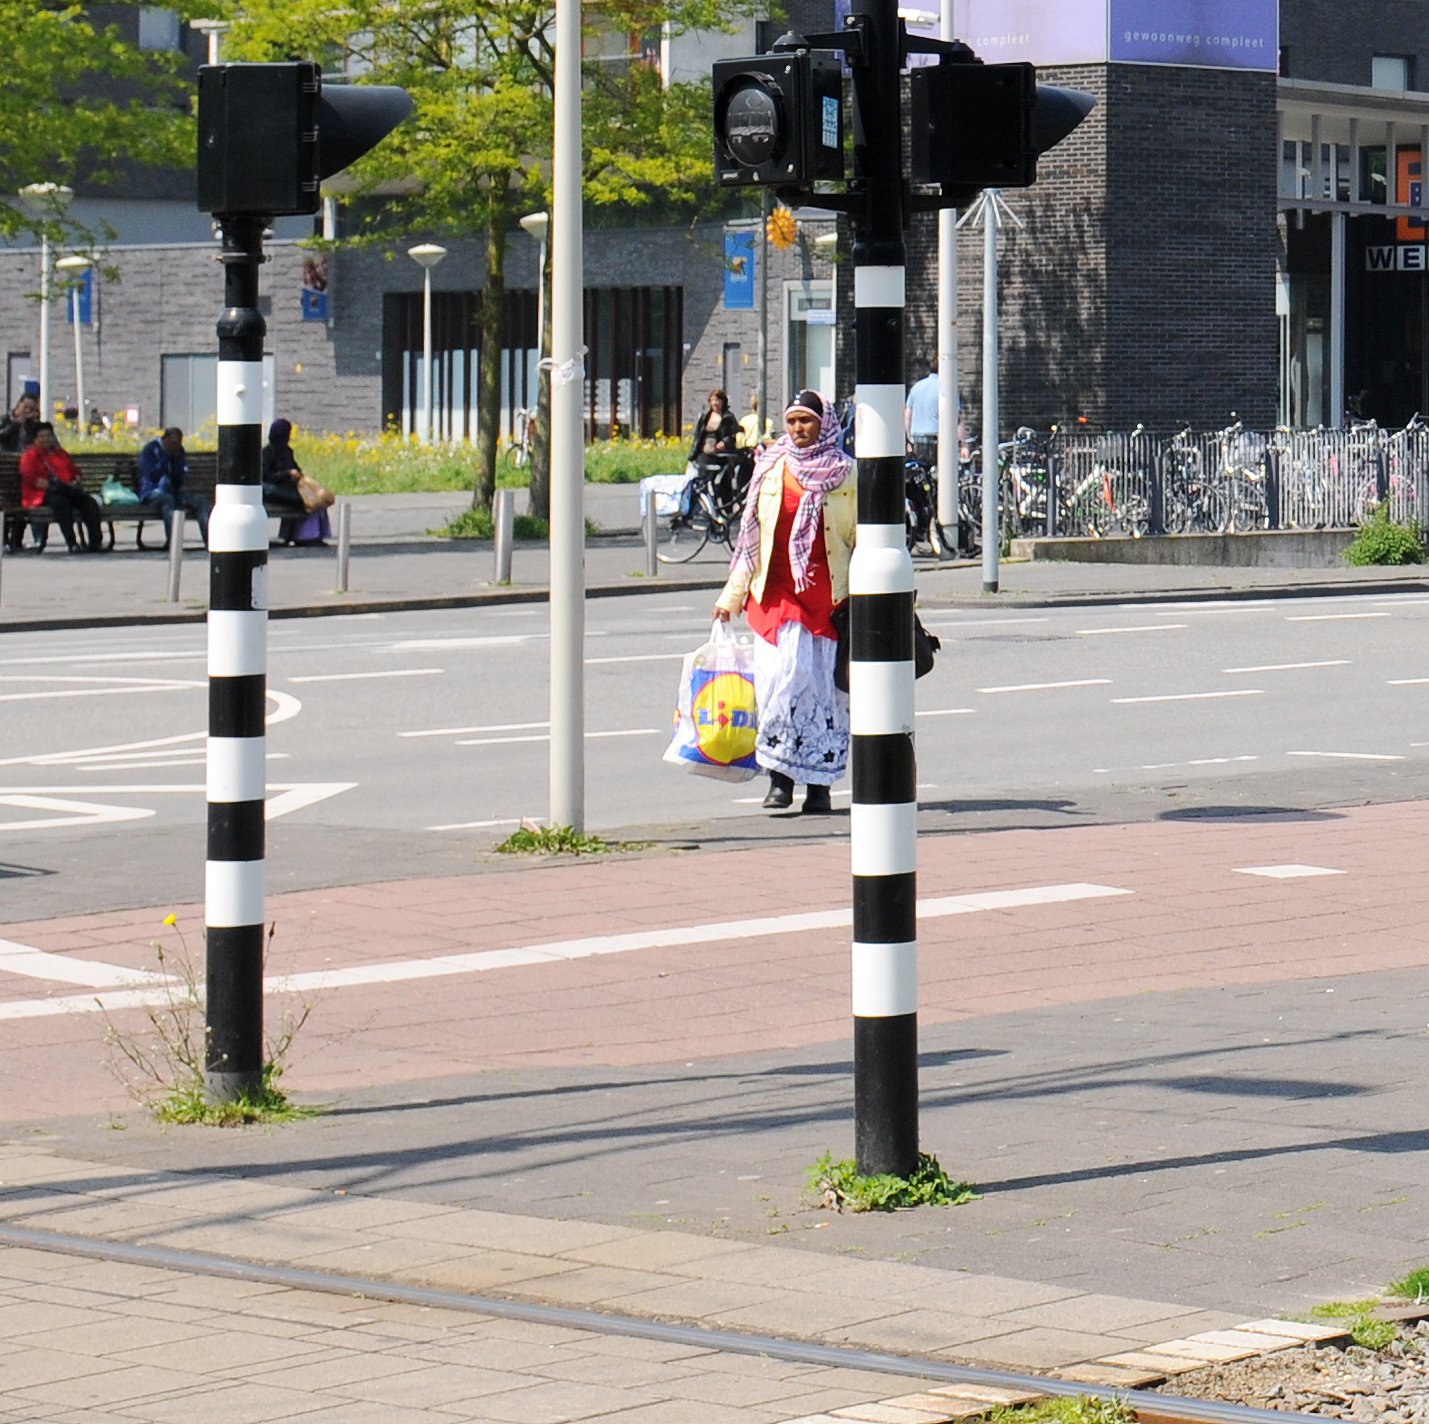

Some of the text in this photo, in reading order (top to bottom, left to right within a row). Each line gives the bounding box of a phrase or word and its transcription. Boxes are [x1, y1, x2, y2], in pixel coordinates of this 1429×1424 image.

[976, 33, 1030, 47] compleet
[1124, 29, 1265, 49] gewoonweg compleet
